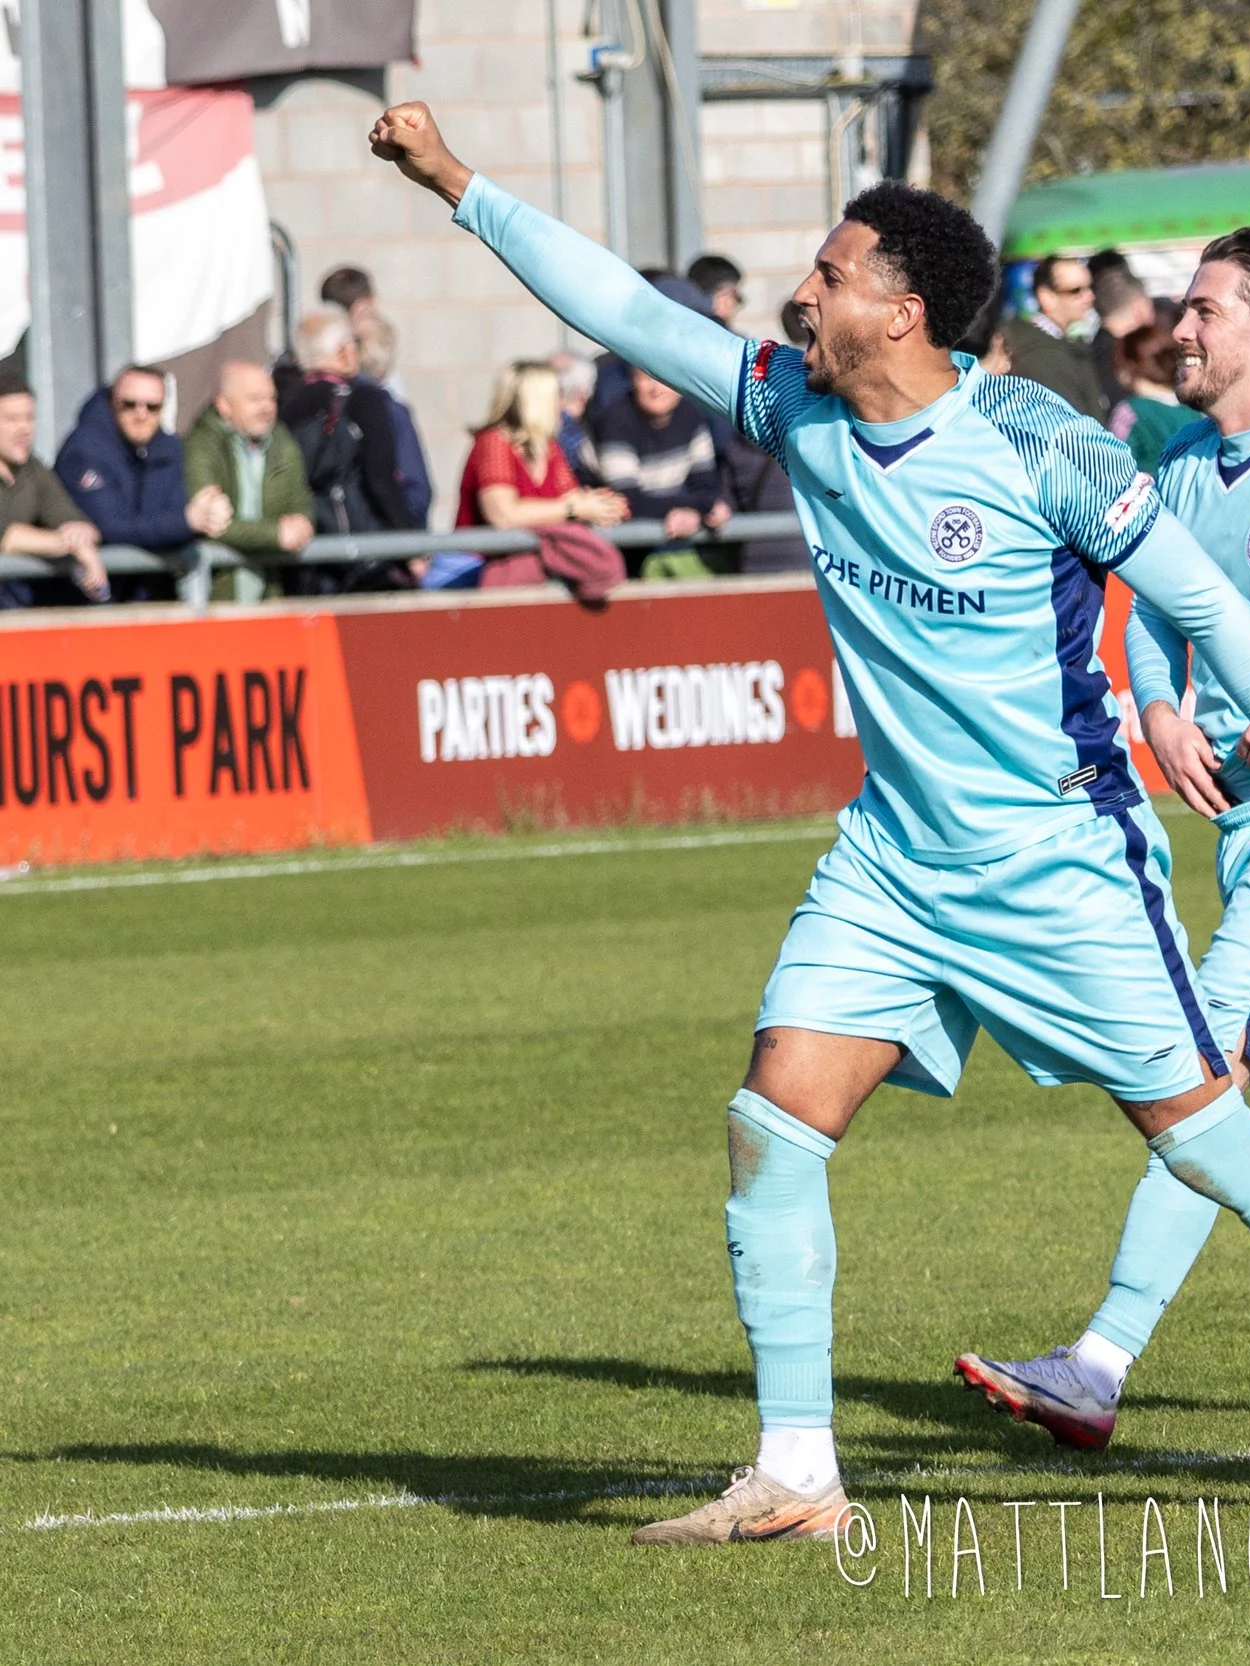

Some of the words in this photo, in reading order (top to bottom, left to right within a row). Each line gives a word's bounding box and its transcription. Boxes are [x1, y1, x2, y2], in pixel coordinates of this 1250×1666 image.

[812, 544, 861, 589] THE
[869, 569, 986, 616] PITMEN
[170, 667, 311, 798] PARK
[417, 672, 556, 763] PARTIES
[604, 659, 786, 752] WEDDINGS
